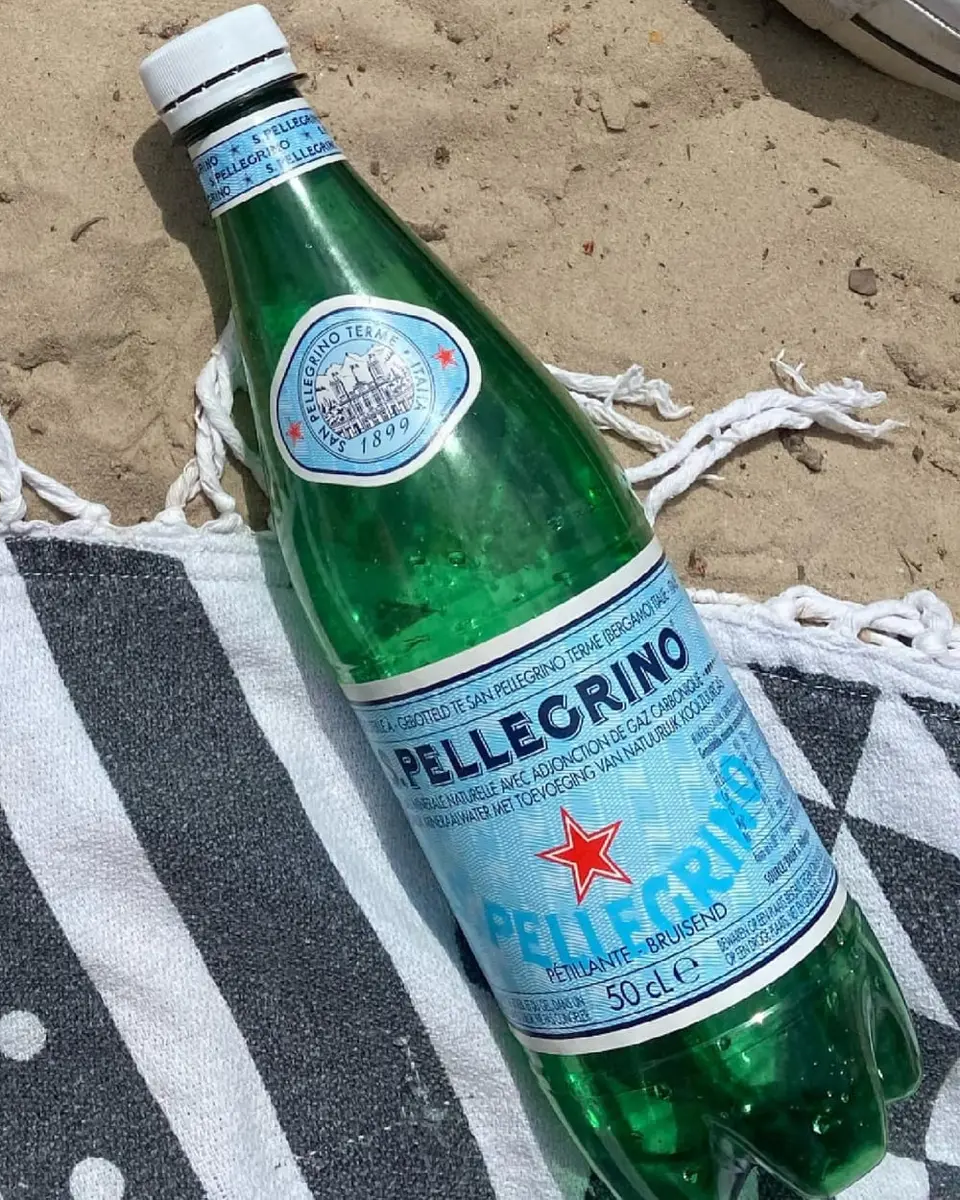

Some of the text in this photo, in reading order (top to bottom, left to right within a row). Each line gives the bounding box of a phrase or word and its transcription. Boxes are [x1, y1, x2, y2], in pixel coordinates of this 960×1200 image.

[303, 331, 340, 423] PELLEGRINO
[345, 325, 399, 348] TERME
[318, 424, 346, 453] SAN
[360, 417, 409, 454] 1899
[396, 704, 451, 731] GEBOTTELD
[495, 655, 567, 700] PELLEGRINO
[565, 633, 604, 665] TERME
[446, 781, 499, 808] NATURELLE
[499, 770, 531, 793] AVEC
[532, 733, 610, 778] ADJONCTION
[610, 724, 626, 744] DE
[628, 711, 651, 734] GAZ
[650, 672, 704, 719] CARBONIQUE
[491, 797, 515, 817] MET
[515, 765, 597, 809] TOEVOEGING
[593, 751, 624, 774] VAN
[624, 716, 682, 757] NATUURLIJK
[546, 902, 728, 984] PÉTILLANTE BRUISEND
[606, 979, 640, 1011] 50
